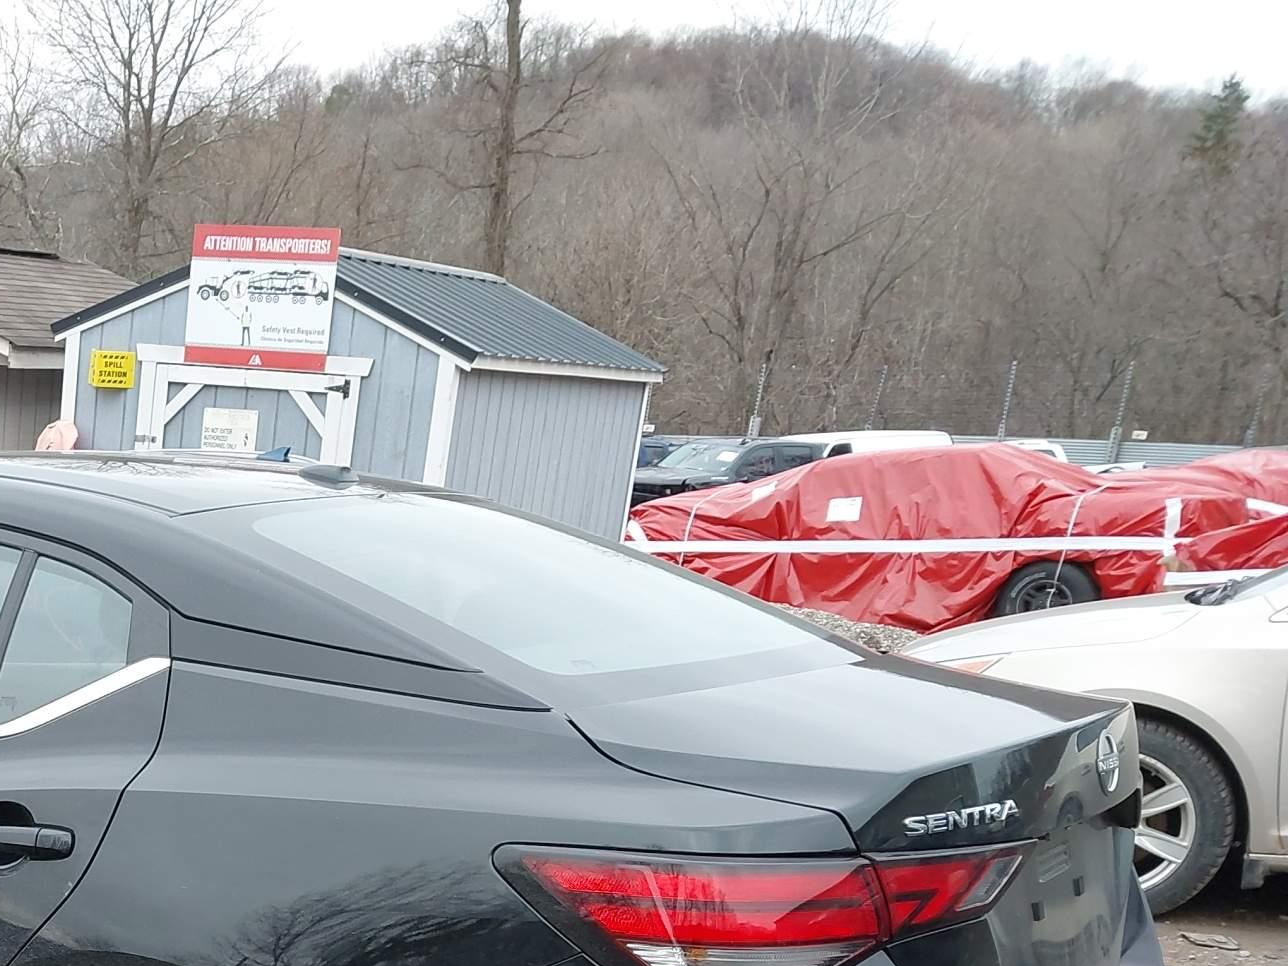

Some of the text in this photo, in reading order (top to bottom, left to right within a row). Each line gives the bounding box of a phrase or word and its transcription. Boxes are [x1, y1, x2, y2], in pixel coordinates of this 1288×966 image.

[203, 235, 332, 255] ATTENTION TRANSPORTERS!
[262, 325, 281, 334] Safety
[297, 327, 325, 336] Required
[104, 361, 123, 369] SPILL
[98, 370, 128, 378] STATION
[902, 799, 1020, 837] SENTRA
